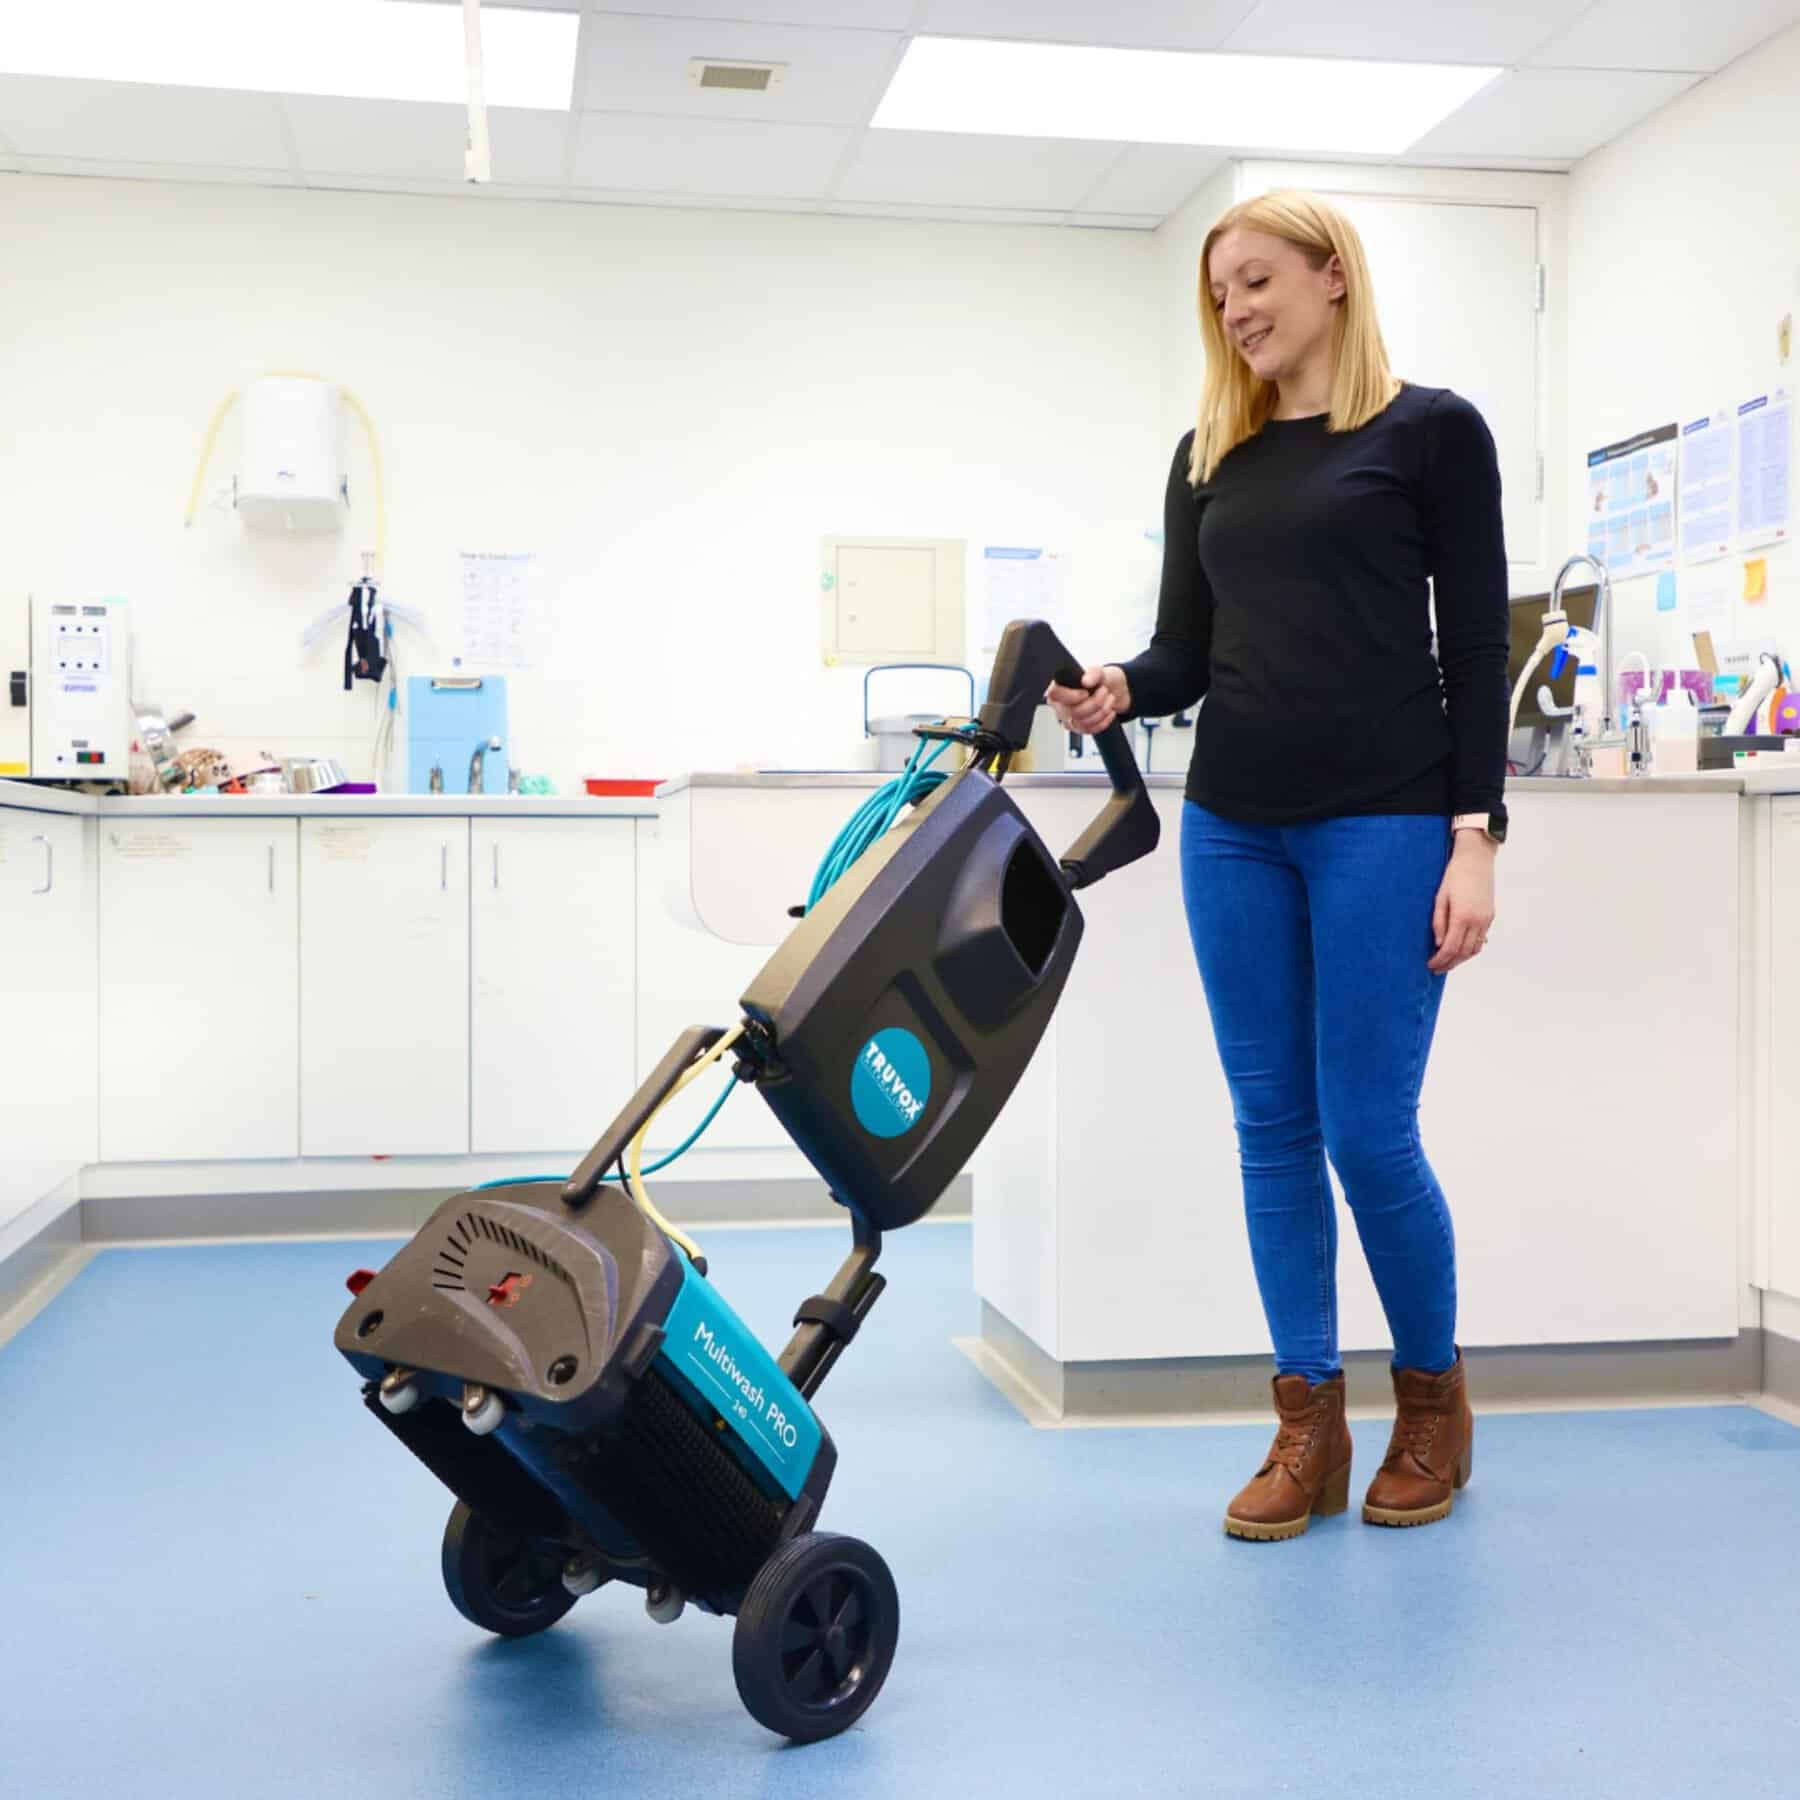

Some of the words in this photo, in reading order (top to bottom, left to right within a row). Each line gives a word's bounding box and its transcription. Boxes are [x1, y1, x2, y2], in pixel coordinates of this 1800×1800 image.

[866, 1042, 921, 1119] TRUVOX
[694, 1322, 764, 1411] Multiwash
[767, 1403, 796, 1447] PRO
